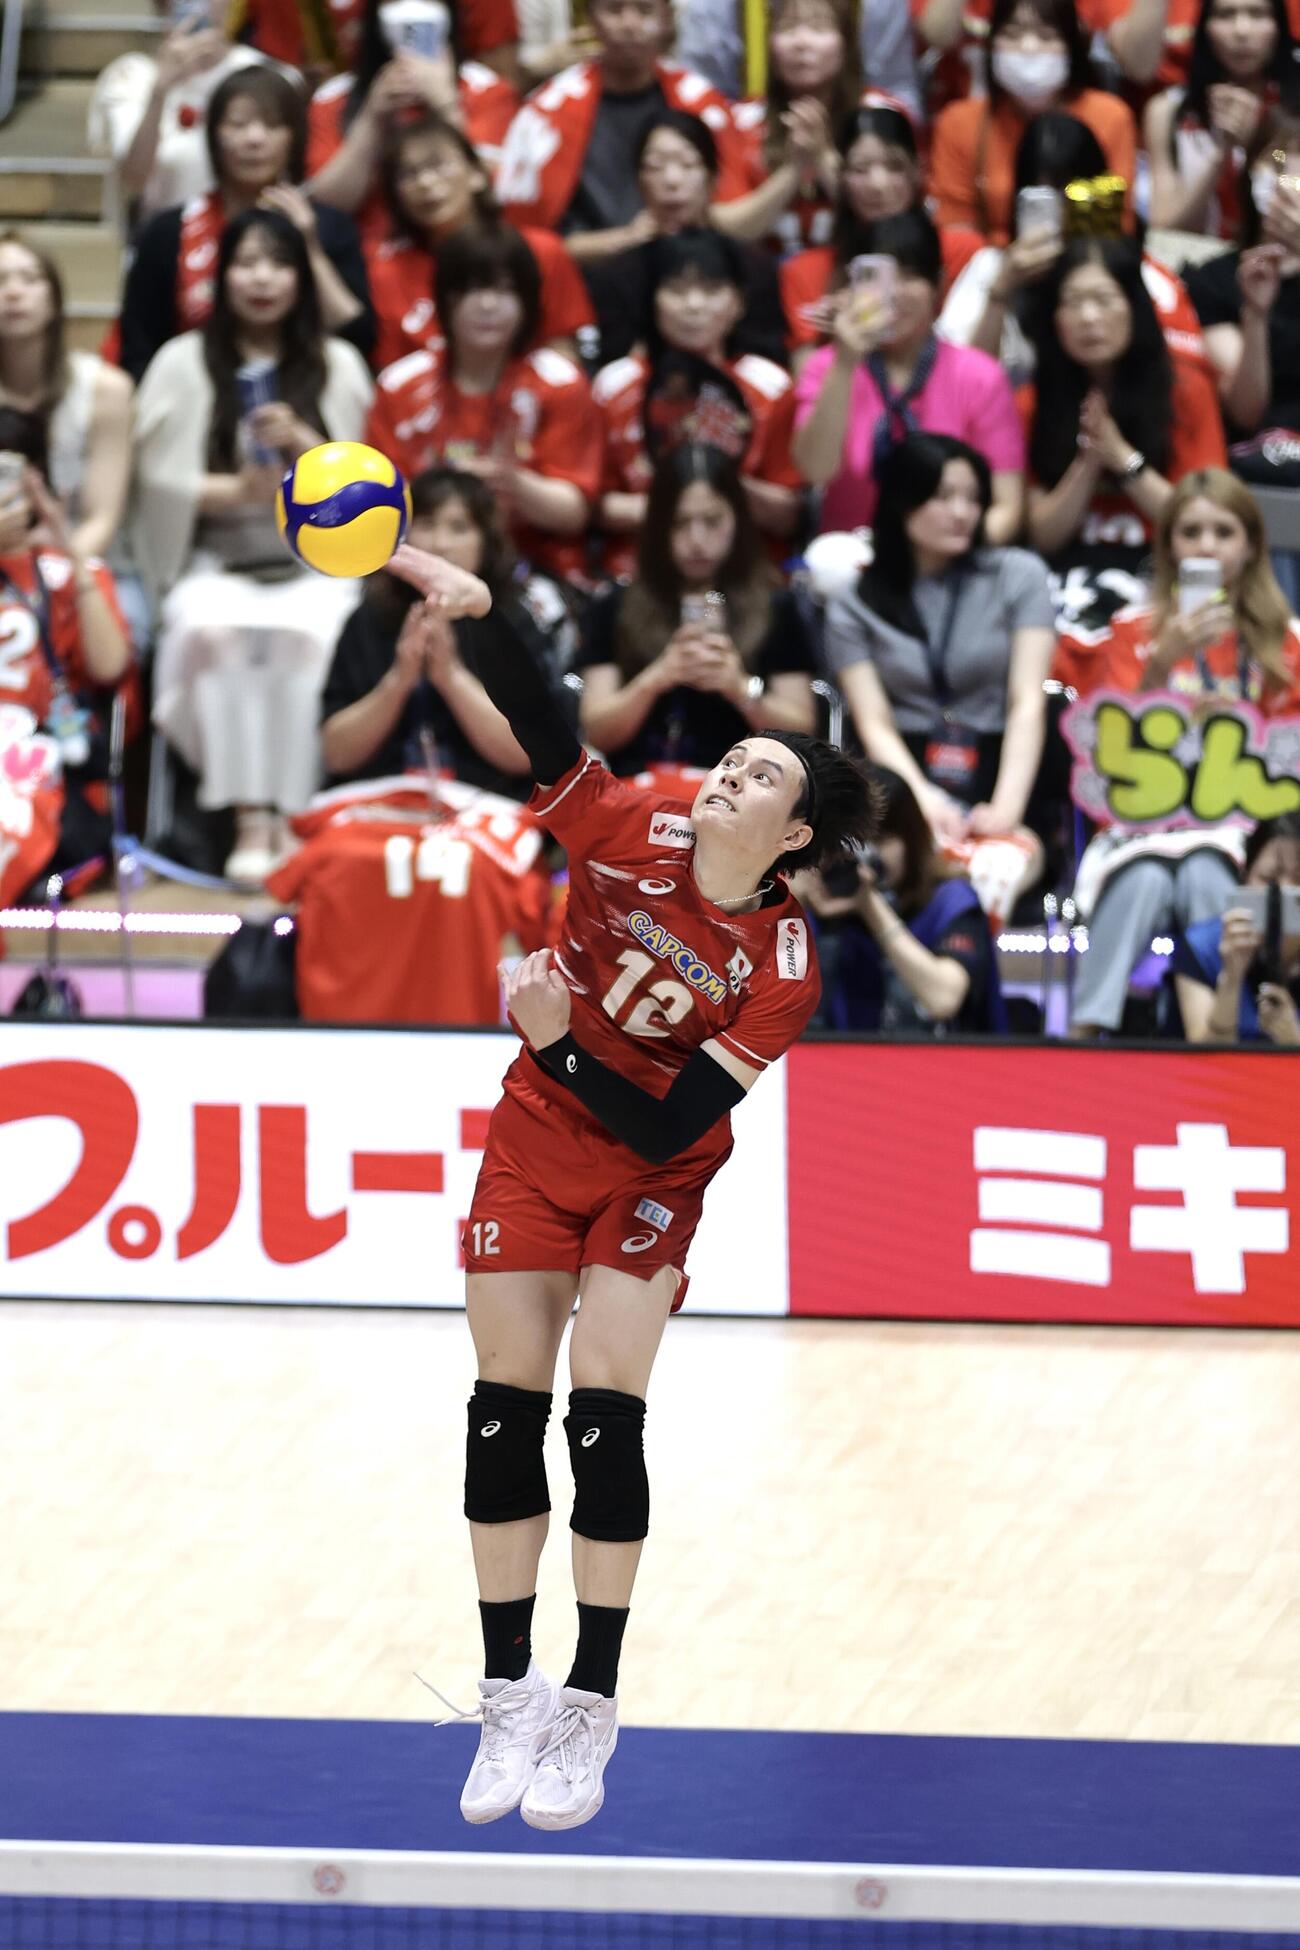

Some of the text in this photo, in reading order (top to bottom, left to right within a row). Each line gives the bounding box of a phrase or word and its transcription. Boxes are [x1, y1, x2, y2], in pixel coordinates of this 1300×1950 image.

[1093, 702, 1300, 823] らん
[668, 828, 697, 841] POWE
[601, 948, 694, 1038] 12
[627, 910, 728, 1005] CAPCOM
[0, 1058, 490, 1269] プルー
[969, 1121, 1290, 1294] ミキ
[472, 1221, 500, 1256] 12
[640, 1200, 668, 1228] TEL
